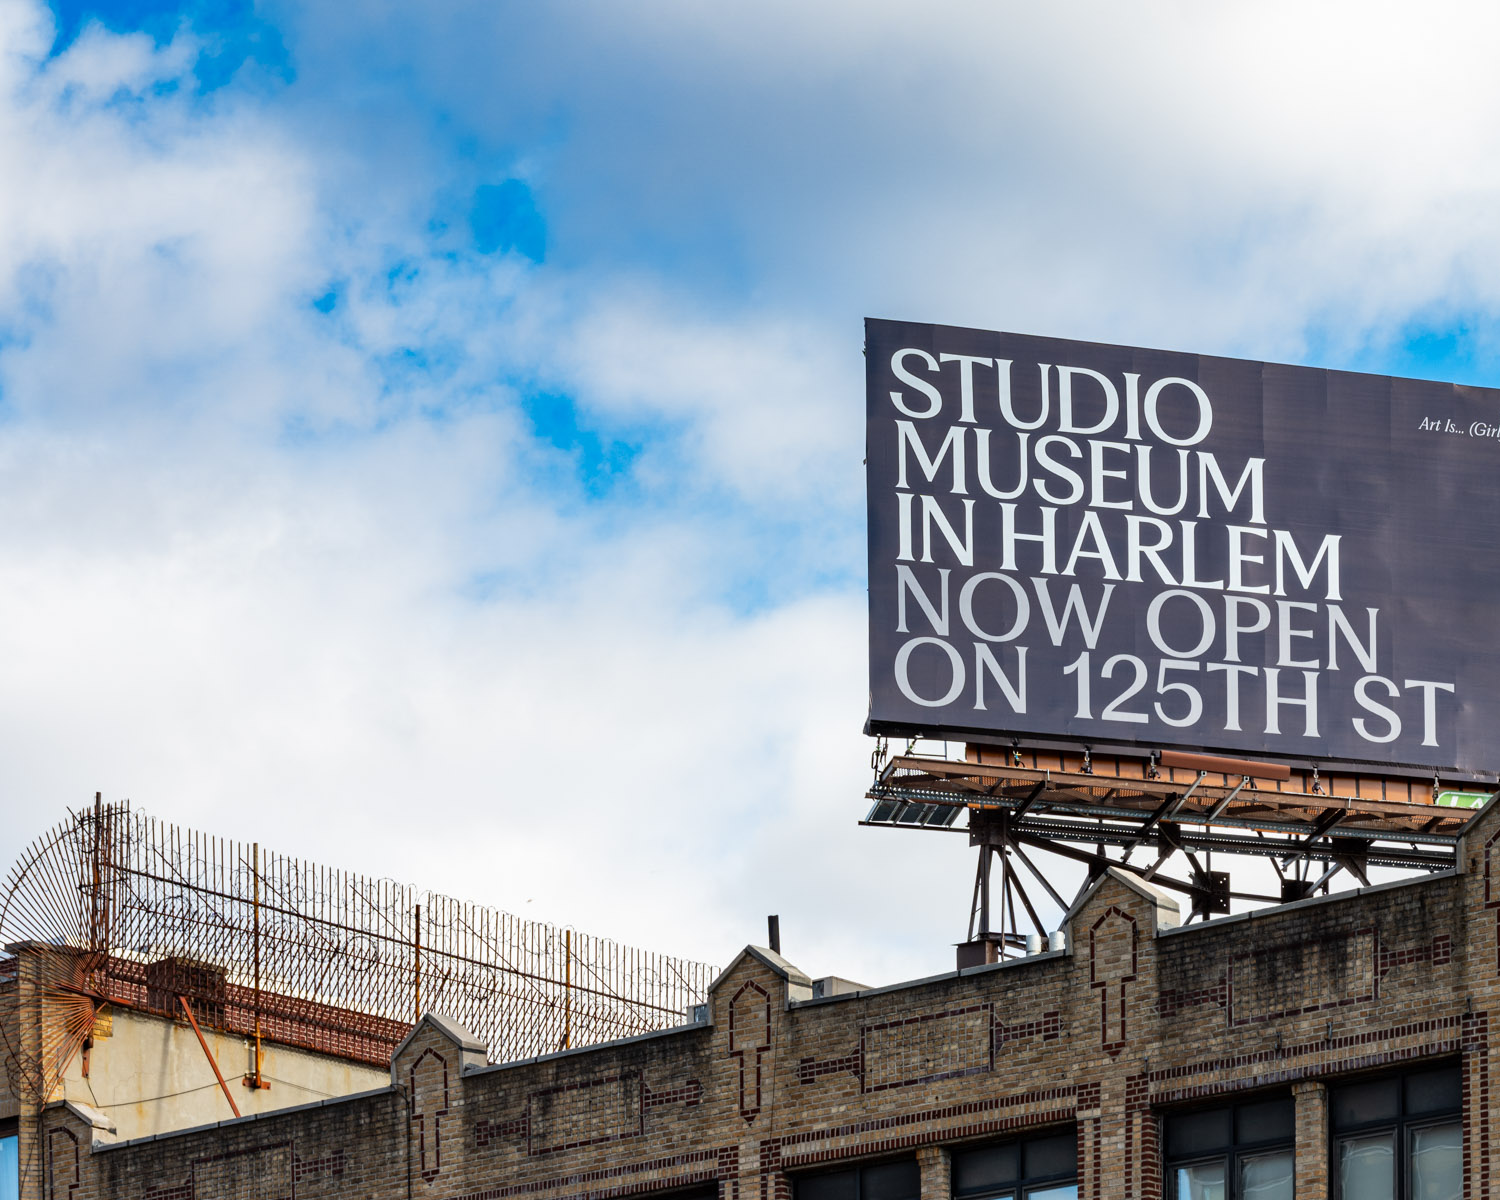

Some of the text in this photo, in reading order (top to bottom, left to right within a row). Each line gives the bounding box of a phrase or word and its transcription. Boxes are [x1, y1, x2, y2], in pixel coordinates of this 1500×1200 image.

[889, 348, 1214, 447] STUDIO
[1418, 416, 1441, 432] Art
[1445, 419, 1464, 434] Is...
[894, 419, 1266, 524] MUSEUM
[895, 492, 1343, 601] IN HARLEM
[895, 564, 1379, 673] NOW OPEN
[894, 636, 1455, 747] ON 125TH ST
